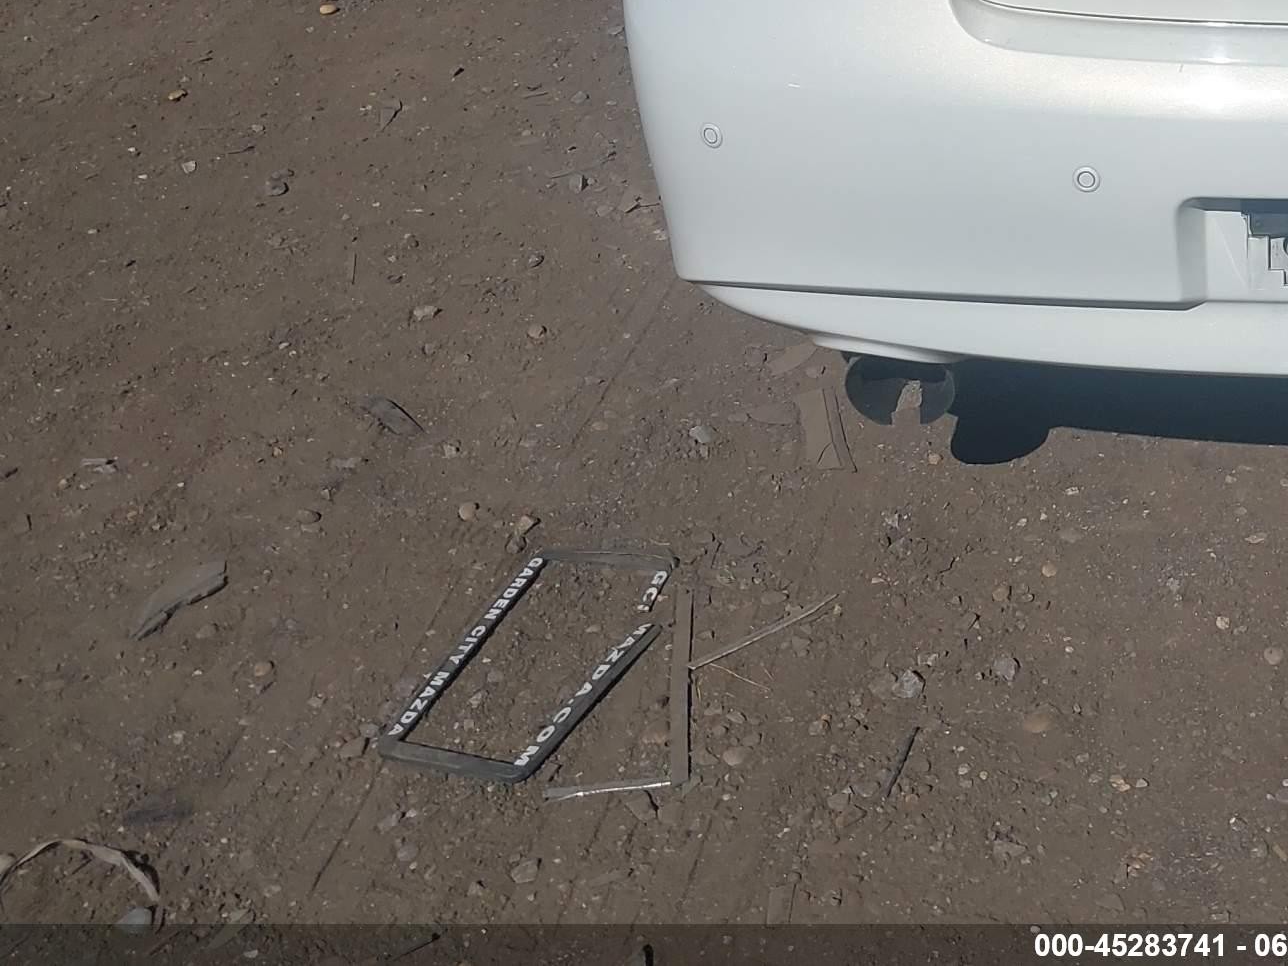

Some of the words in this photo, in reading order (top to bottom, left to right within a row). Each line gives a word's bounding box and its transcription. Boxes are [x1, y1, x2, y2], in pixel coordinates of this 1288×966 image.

[484, 557, 544, 620] GARDEN
[450, 625, 486, 665] CITY
[388, 671, 450, 736] MAZDA
